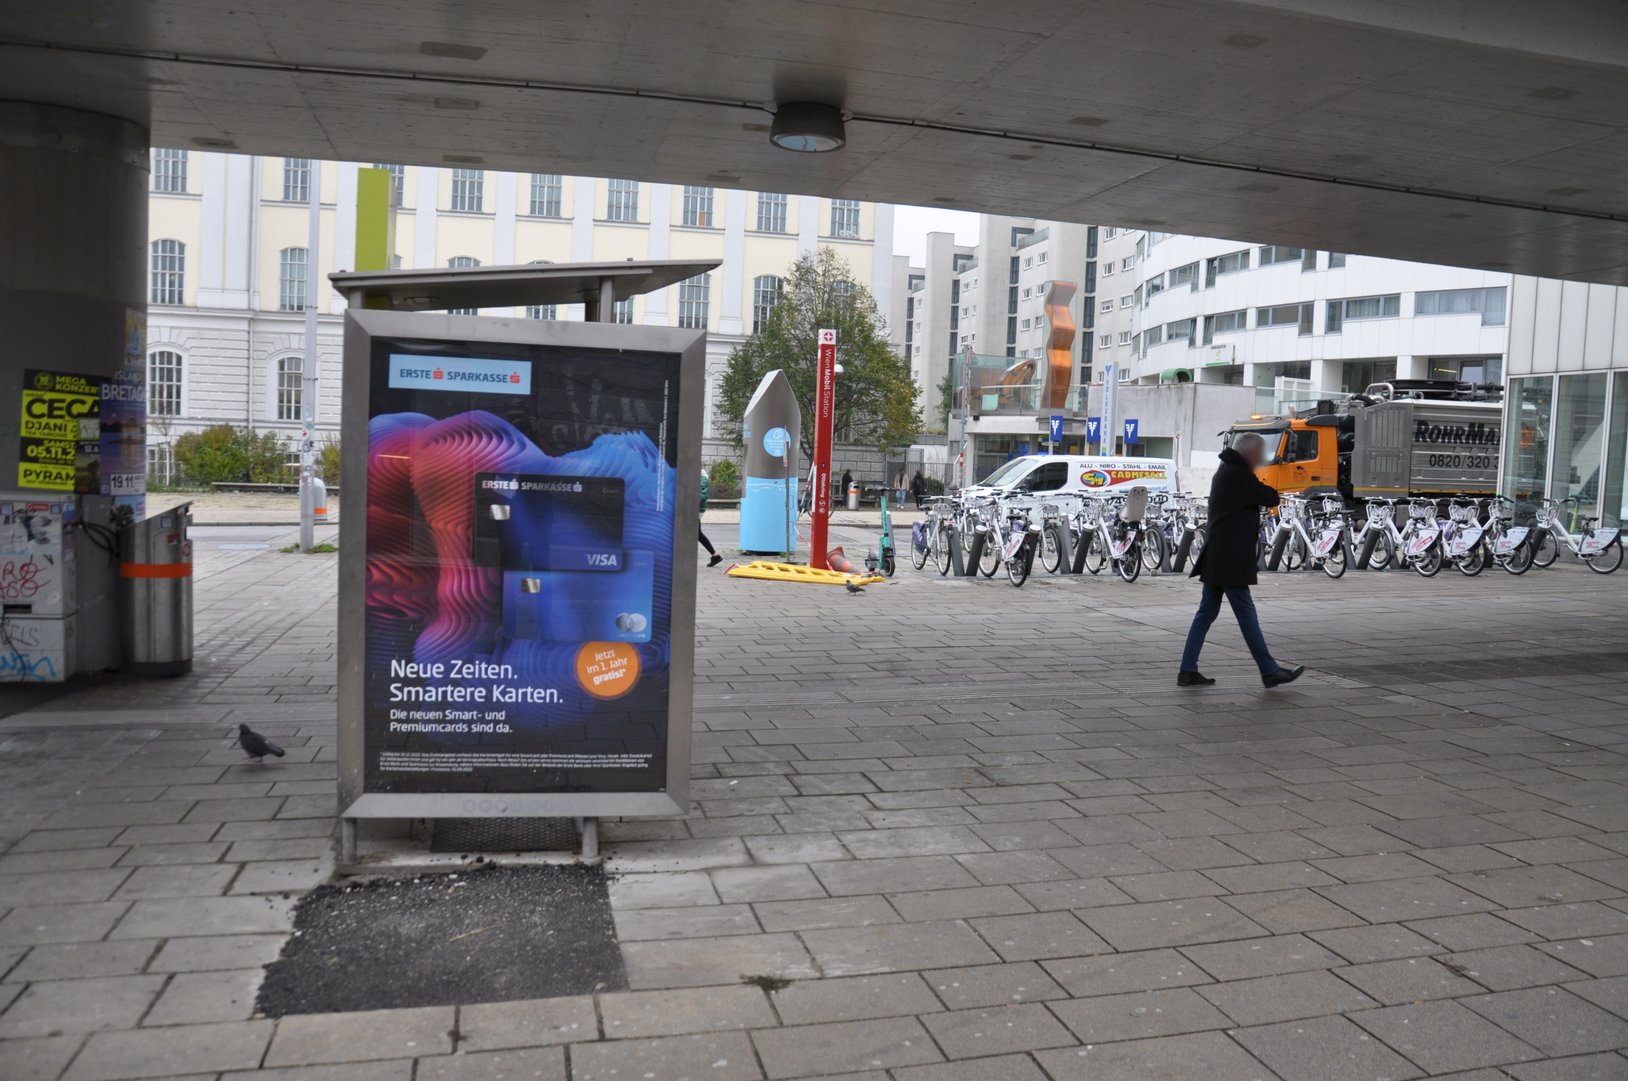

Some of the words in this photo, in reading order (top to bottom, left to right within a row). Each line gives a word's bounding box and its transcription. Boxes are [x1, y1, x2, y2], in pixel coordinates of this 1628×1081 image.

[56, 375, 87, 385] MEGA
[400, 368, 431, 379] ERSTE
[447, 371, 508, 383] SPARKASSE
[26, 397, 100, 419] CECA
[25, 420, 67, 432] DJANI
[1429, 454, 1490, 468] 0820/320
[482, 480, 508, 490] ERSTE
[521, 481, 572, 492] SPARKASSE
[586, 554, 617, 566] VISA
[610, 657, 628, 669] Jahr
[390, 659, 445, 679] Neue
[449, 660, 518, 680] Zeiten.
[389, 683, 487, 702] Smartere
[492, 684, 564, 704] Karten.
[389, 709, 408, 720] Die
[409, 710, 443, 720] neuen
[444, 709, 482, 720] Smart-
[485, 710, 506, 720] und
[389, 722, 469, 732] Premiumcards
[471, 722, 494, 733] sind
[495, 723, 513, 733] da.
